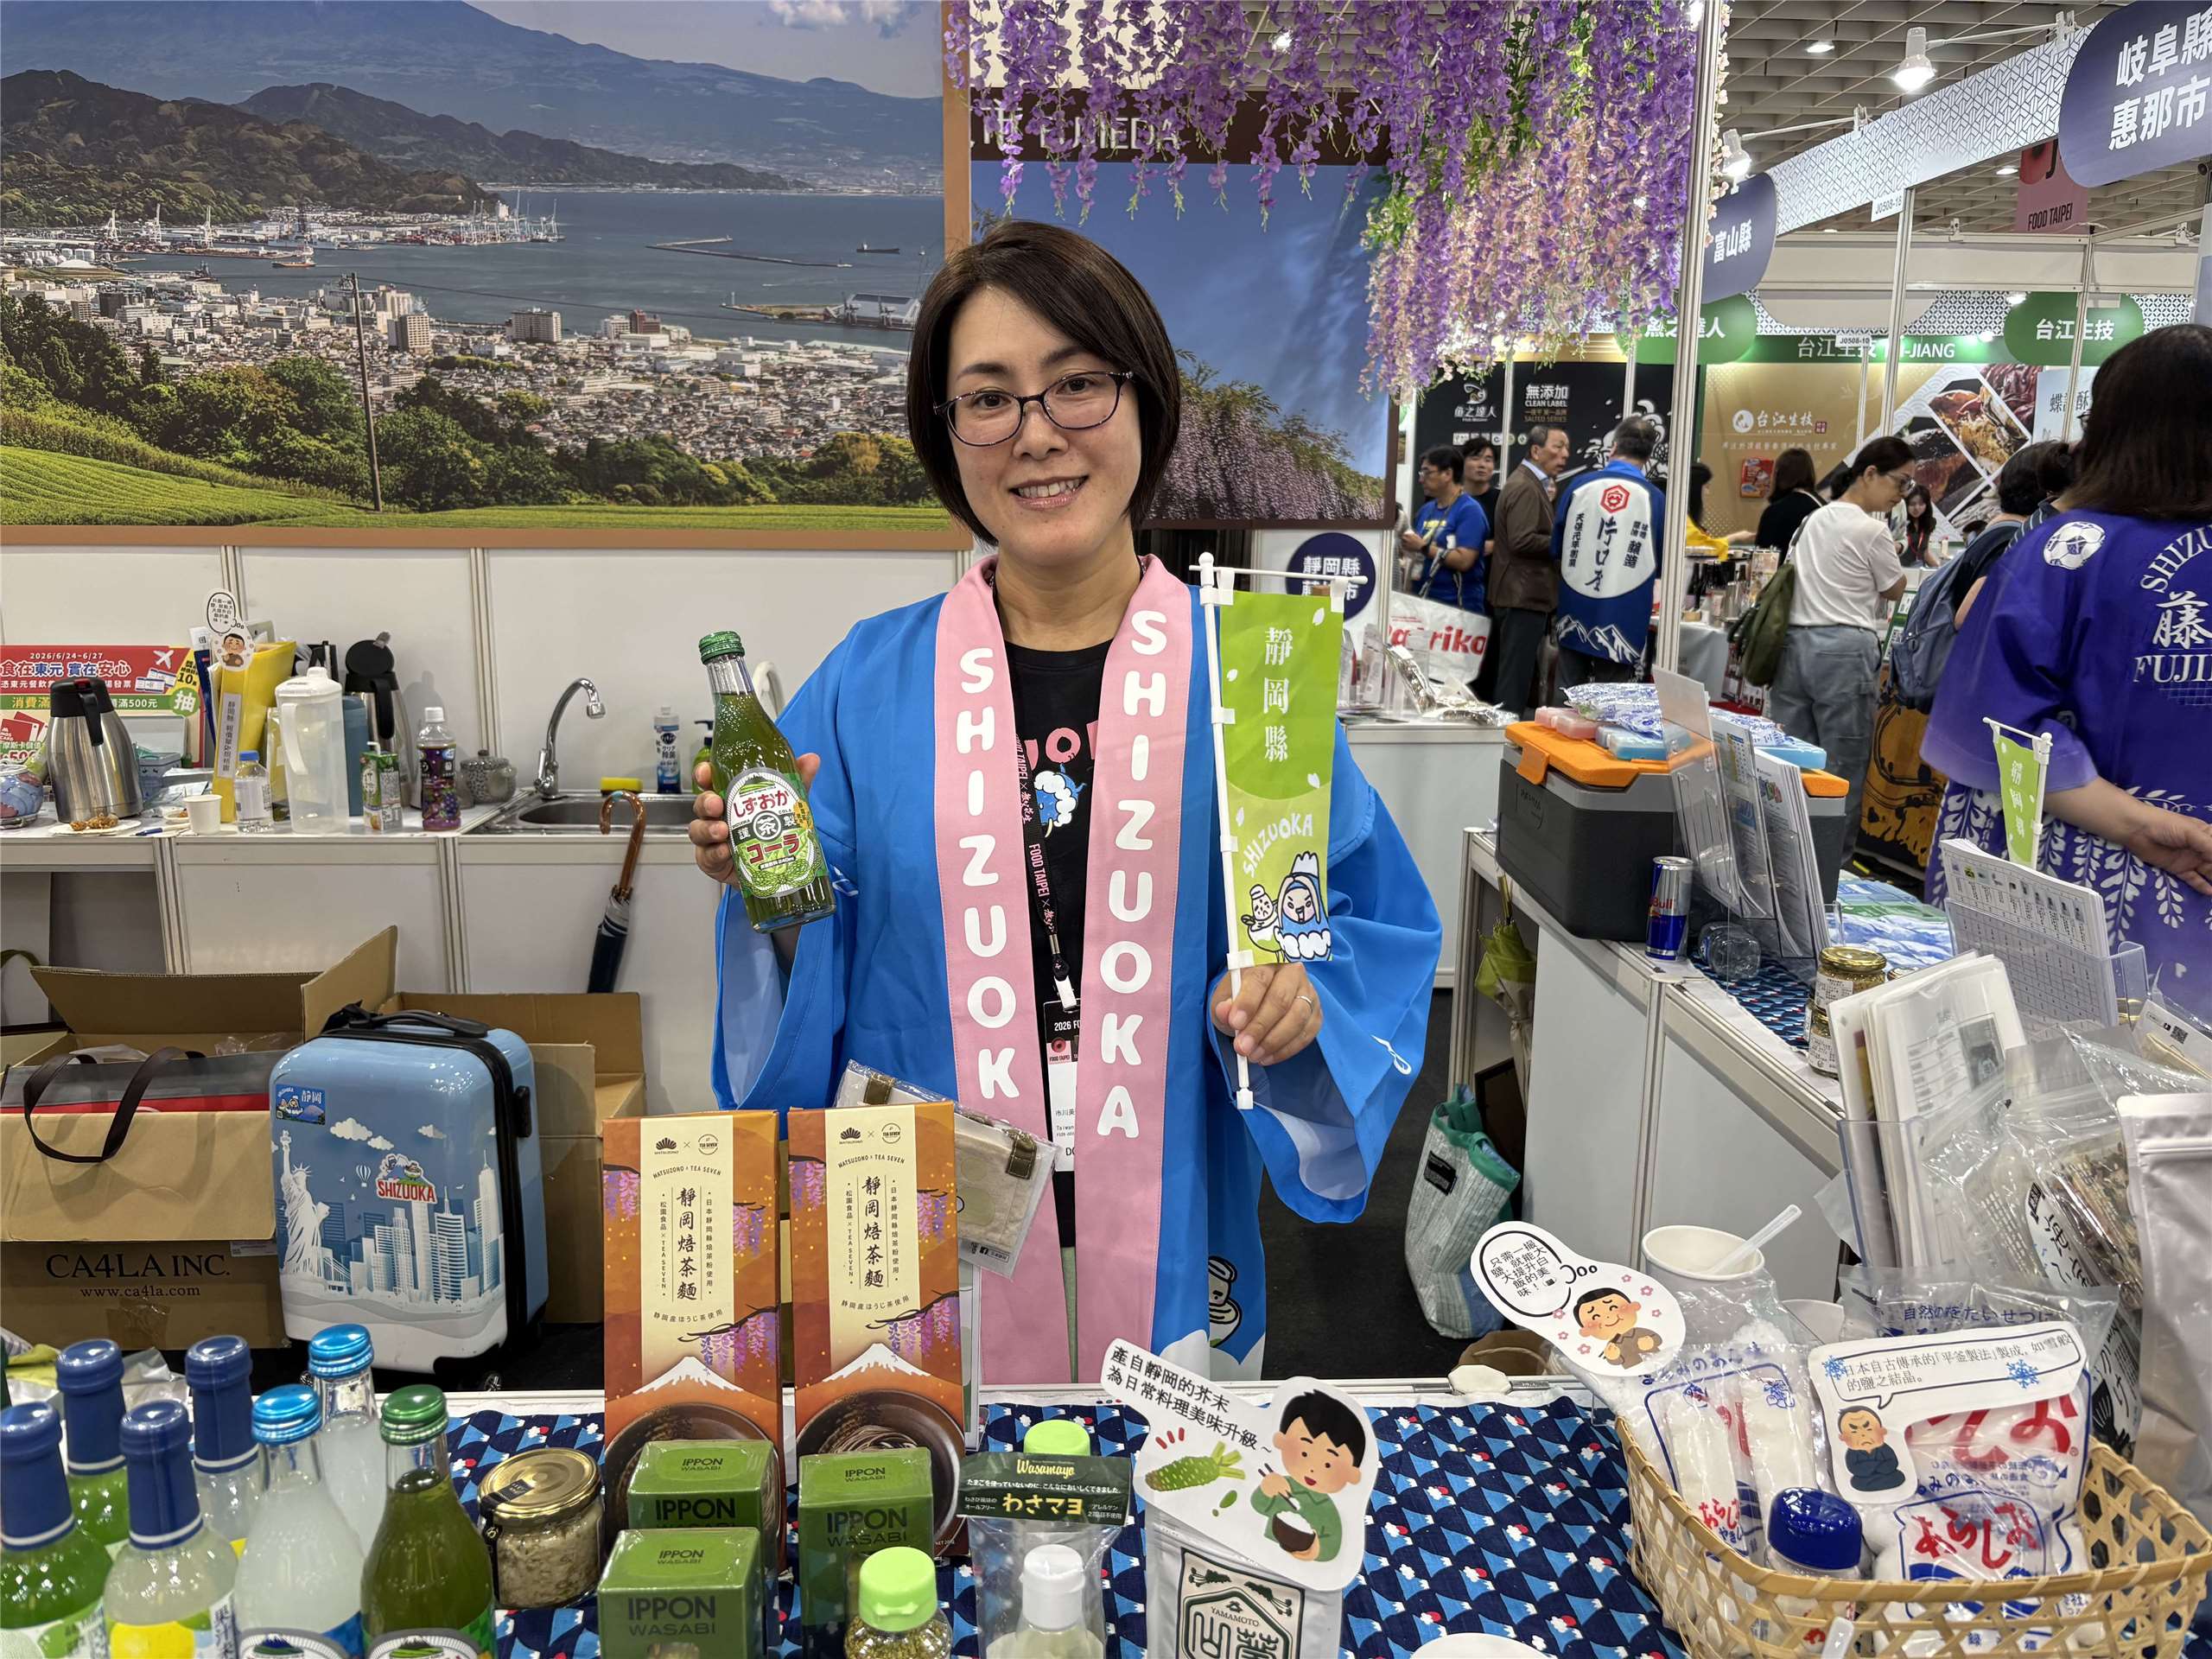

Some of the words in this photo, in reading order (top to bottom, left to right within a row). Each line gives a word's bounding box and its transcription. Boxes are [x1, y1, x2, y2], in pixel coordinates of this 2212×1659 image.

[2108, 74, 2211, 150] 惠那市
[2027, 210, 2048, 232] FOOD
[2050, 202, 2074, 226] TAIPEI
[1713, 219, 1752, 264] 富山縣
[1525, 384, 1569, 399] 無添加
[2152, 590, 2212, 650] 藤
[1, 661, 63, 677] 食在東元
[68, 661, 131, 677] 實在安心
[174, 690, 196, 711] 抽
[1262, 627, 1294, 762] 靜岡縣
[733, 790, 790, 818] しずおか
[757, 816, 778, 836] 茶
[747, 833, 800, 865] コーラ
[1028, 842, 1044, 868] FOOD
[1243, 811, 1314, 880] SHIZUOKA
[956, 647, 1020, 1123] SHIZUOK
[1033, 869, 1050, 898] TAIPEI
[1096, 610, 1167, 1139] SHIZUOKA
[1053, 1020, 1071, 1032] 2026
[652, 1166, 684, 1179] MATSUZONO
[703, 1166, 721, 1176] SEVEN
[837, 1154, 868, 1168] MATSUZONO
[887, 1154, 906, 1165] SEVEN
[378, 1180, 436, 1203] SHIZUOKA
[676, 1187, 697, 1300] 靜岡焙茶麵
[861, 1176, 884, 1287] 靜岡焙茶麵
[46, 1252, 166, 1279] CA4LA
[172, 1254, 231, 1277] INC.
[1502, 1256, 1548, 1284] 大提升白
[80, 1285, 201, 1297] www.ca4la.com
[1110, 1344, 1230, 1413] 產自靜岡的芥末
[682, 1458, 723, 1466] IPPON
[845, 1467, 886, 1478] IPPON
[1016, 1459, 1076, 1479] Wasamayo
[655, 1497, 736, 1521] IPPON
[1002, 1492, 1084, 1515] わさマヨ
[826, 1507, 907, 1534] IPPON
[828, 1531, 906, 1548] WASABI
[658, 1549, 704, 1559] IPPON
[628, 1595, 715, 1621] IPPON
[1210, 1606, 1260, 1627] YAMAMOTO
[629, 1623, 716, 1637] WASABI
